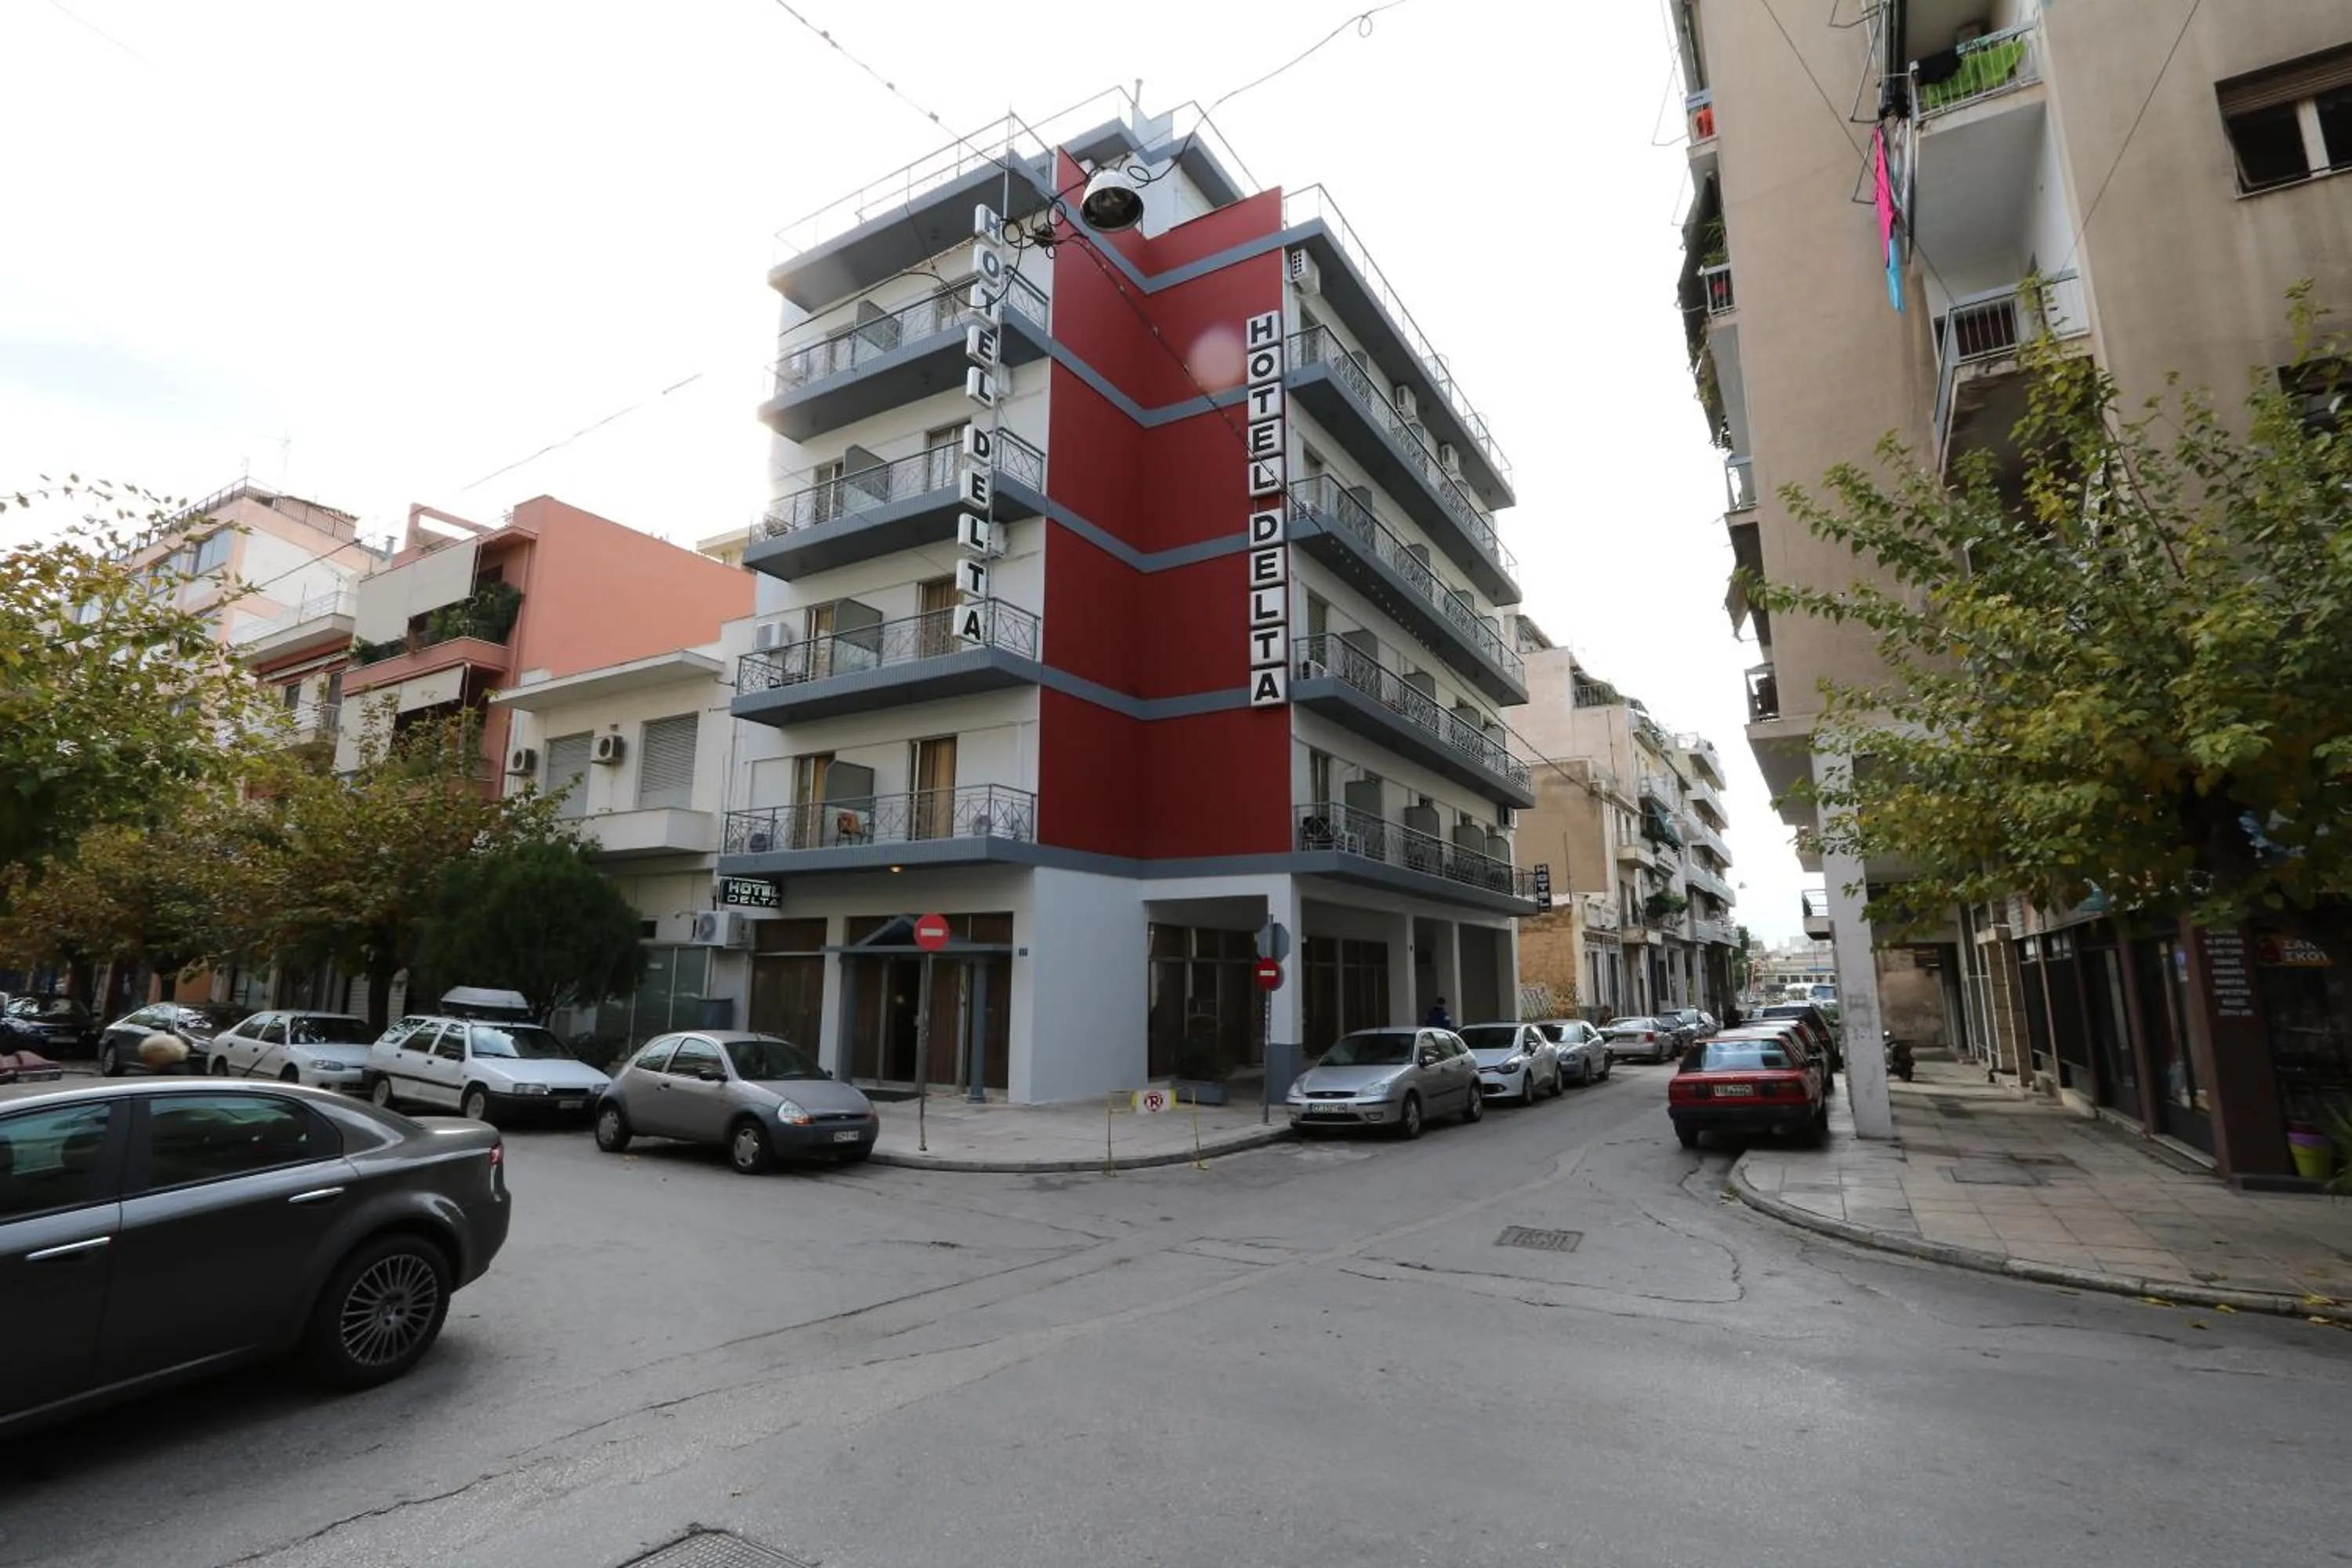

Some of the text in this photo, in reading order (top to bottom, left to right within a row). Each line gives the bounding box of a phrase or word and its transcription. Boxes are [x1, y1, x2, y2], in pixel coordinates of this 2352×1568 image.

[963, 206, 1002, 641] HOTEL DELTA
[1250, 315, 1279, 702] HOTEL DELTA
[727, 895, 779, 906] DELTA
[728, 881, 780, 897] HOTEL
